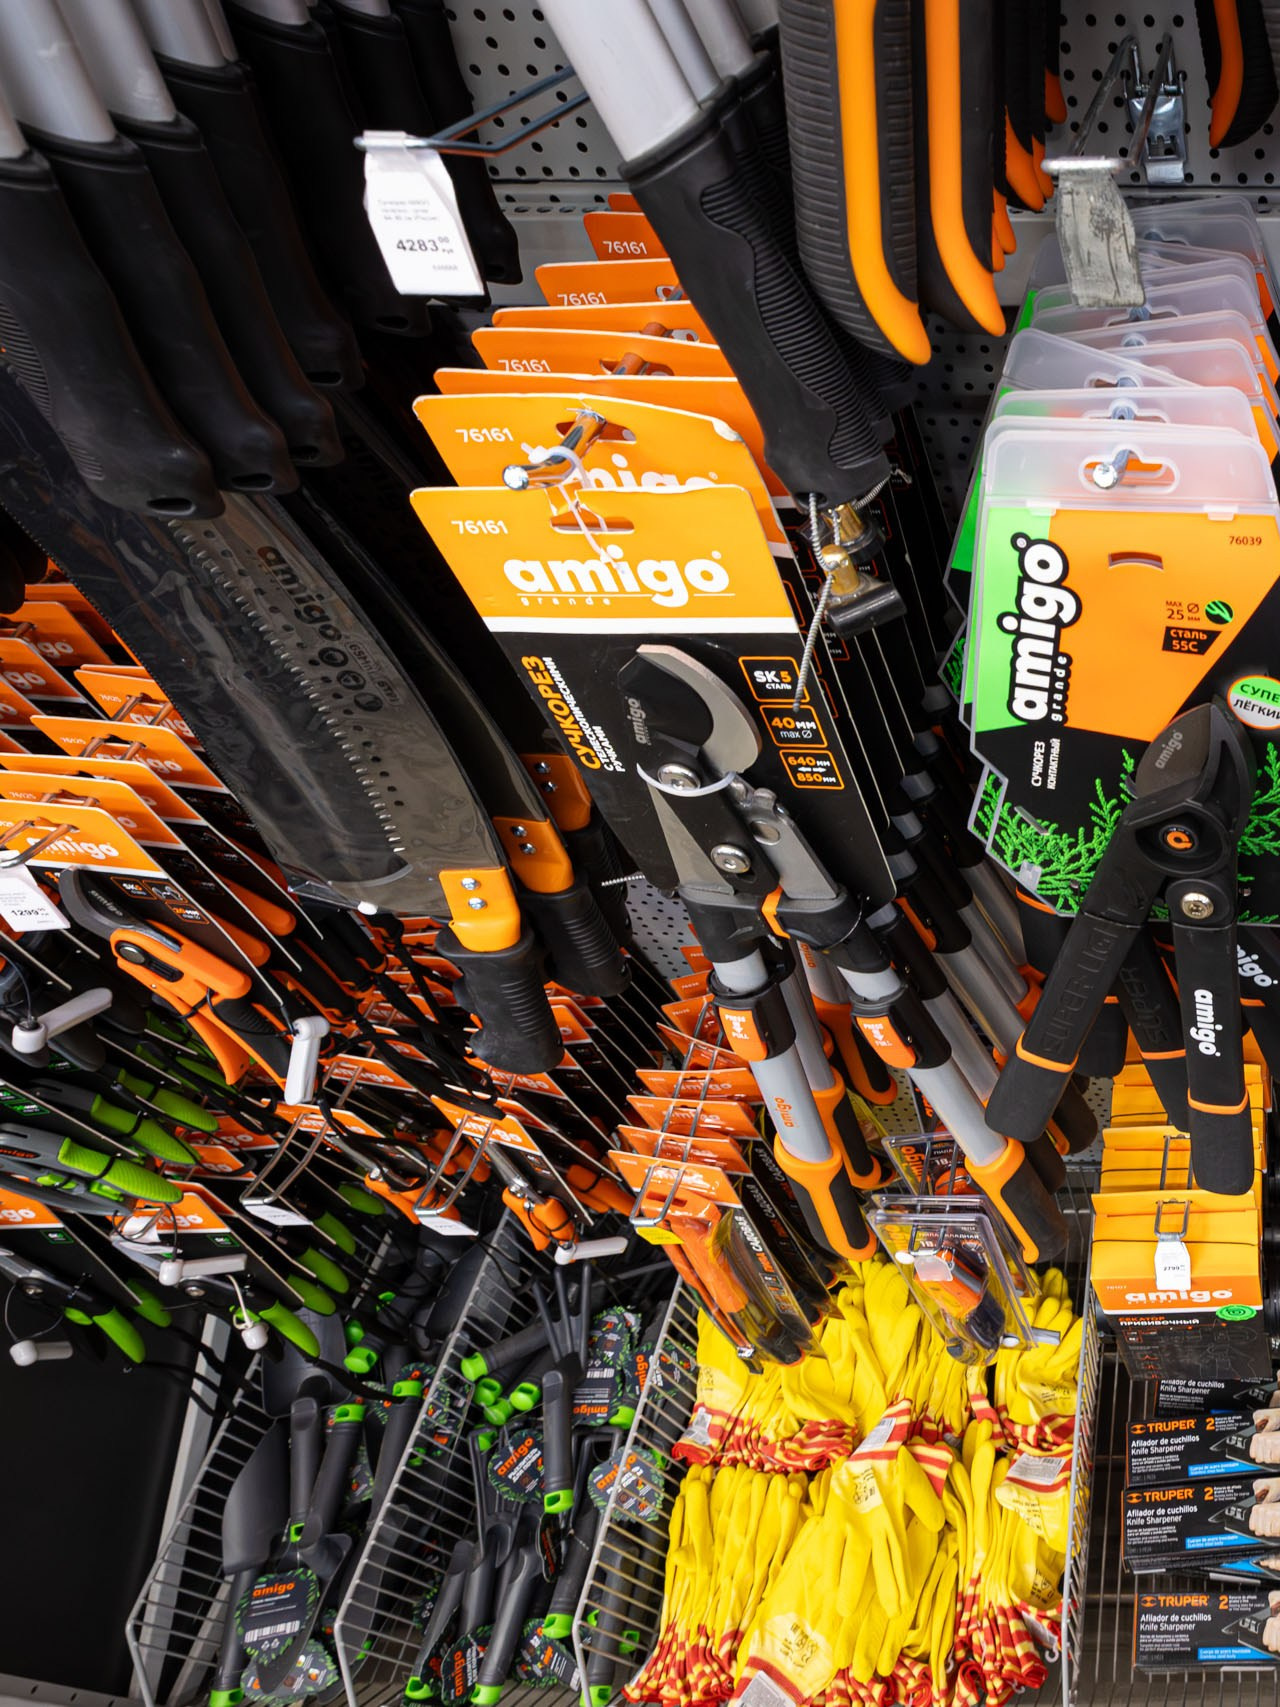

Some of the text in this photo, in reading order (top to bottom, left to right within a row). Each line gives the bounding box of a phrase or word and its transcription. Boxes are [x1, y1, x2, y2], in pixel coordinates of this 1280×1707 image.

[396, 240, 439, 252] 4283
[603, 240, 647, 255] 76161
[557, 291, 607, 306] 76161
[498, 359, 551, 372] 76161
[456, 428, 514, 443] 76161
[451, 520, 508, 535] 76161
[1228, 535, 1263, 546] 76039
[503, 544, 730, 608] amigo
[257, 546, 342, 641] amigo
[521, 596, 611, 606] grande
[1166, 609, 1184, 621] 25
[1001, 536, 1080, 721] amigo
[1170, 628, 1208, 640] сталь
[754, 670, 778, 682] SK
[765, 683, 792, 691] СТАЛЬ
[1051, 656, 1069, 722] grande
[521, 655, 601, 770] СУЧКОРЕЗ
[625, 695, 647, 744] amigo
[780, 729, 801, 739] max
[1154, 730, 1183, 769] amigo
[1031, 741, 1045, 787] СУЧКОРЕЗ
[1047, 738, 1061, 789] КОНТАКТНЫЙ
[1193, 988, 1222, 1058] amigo
[774, 1097, 795, 1128] amigo
[1125, 1288, 1233, 1303] amigo
[1177, 1386, 1211, 1395] Sharpener
[1195, 1380, 1225, 1388] cuchillos
[573, 1405, 609, 1415] amigo
[1147, 1419, 1196, 1433] TRUPER
[1205, 1418, 1215, 1431] 2
[1131, 1435, 1200, 1448] Afilador de cuchillos
[497, 1436, 535, 1477] amigo
[1131, 1444, 1185, 1455] Knife Sharpener
[1144, 1488, 1193, 1503] TRUPER
[1203, 1487, 1214, 1501] 2
[1126, 1505, 1198, 1517] Afilador de cuchillos
[1126, 1514, 1182, 1525] Knife Sharpener
[252, 1582, 296, 1598] amigo
[1158, 1595, 1208, 1608] TRUPER
[1218, 1595, 1229, 1609] 2
[1140, 1613, 1212, 1622] Afilador de cuchillos
[1140, 1623, 1196, 1632] Knife Sharpener
[453, 1650, 467, 1697] amigo
